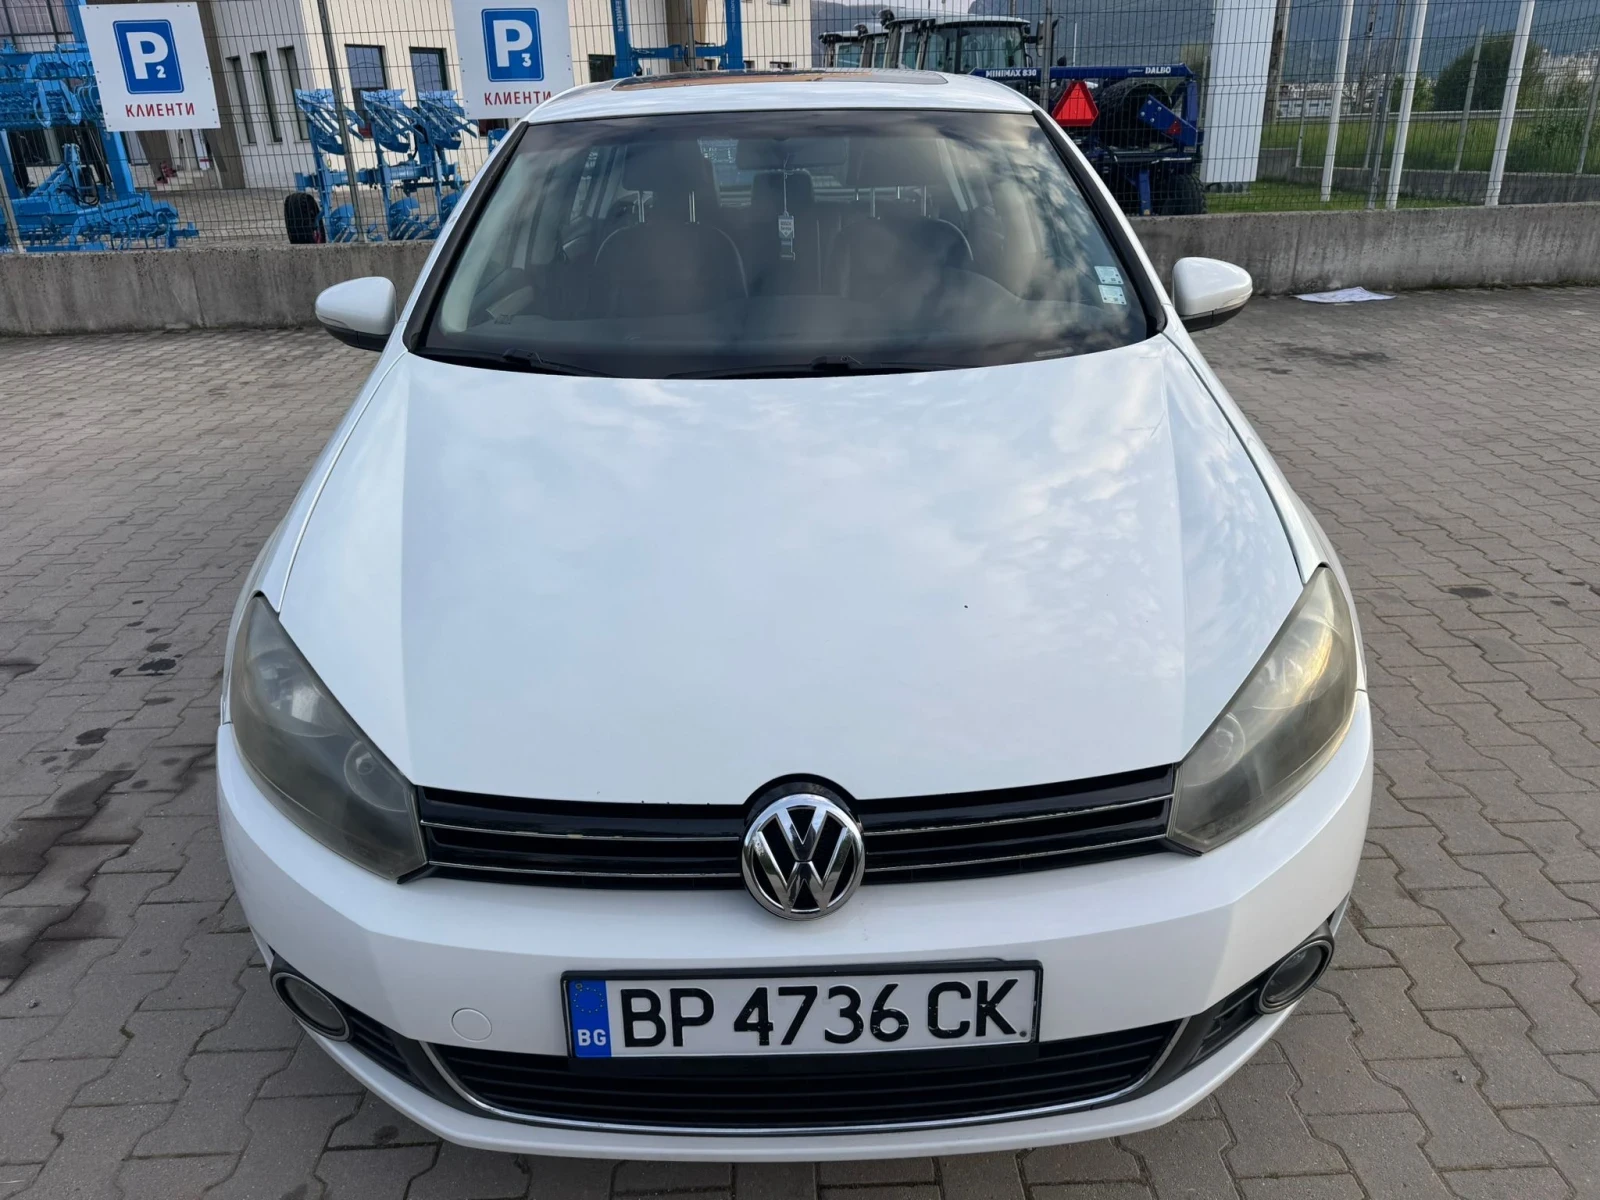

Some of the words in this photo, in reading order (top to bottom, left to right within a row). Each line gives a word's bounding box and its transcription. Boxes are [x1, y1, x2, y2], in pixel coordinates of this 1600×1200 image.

[1022, 68, 1037, 77] 830
[1145, 66, 1171, 75] DALBO
[125, 102, 195, 118] КЛИЕНТИ
[620, 987, 715, 1048] BP
[733, 983, 910, 1047] 4736
[927, 978, 1019, 1040] CK
[577, 1028, 607, 1047] BG
